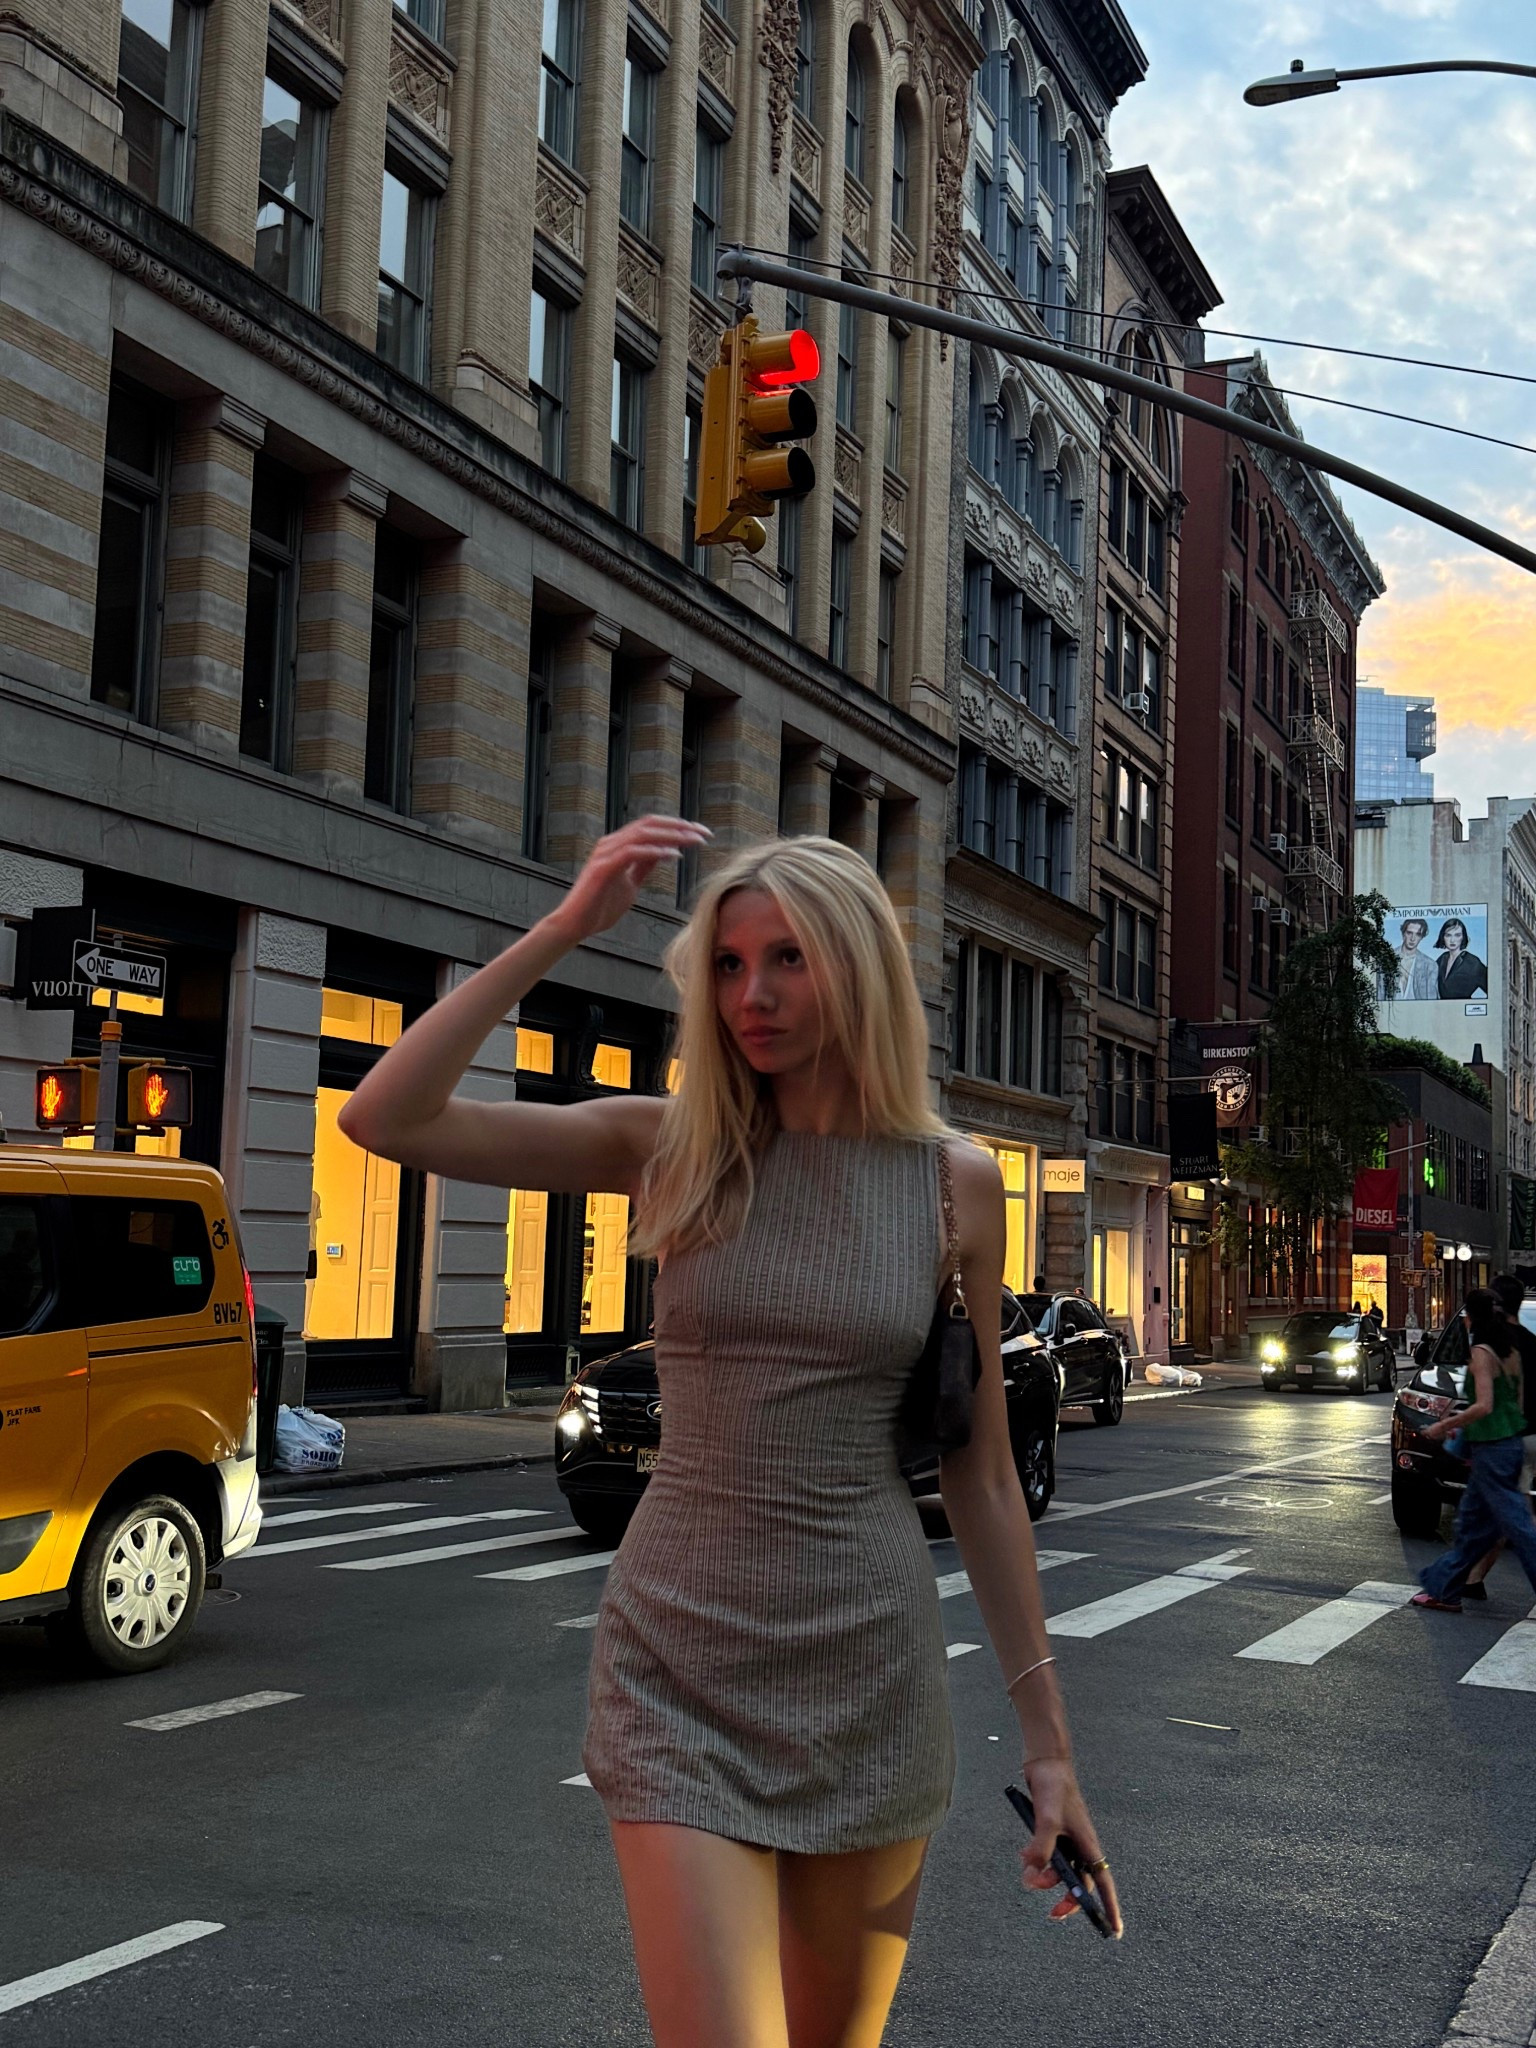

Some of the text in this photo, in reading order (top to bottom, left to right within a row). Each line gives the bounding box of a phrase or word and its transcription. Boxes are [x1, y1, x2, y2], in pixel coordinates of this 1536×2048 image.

[1393, 907, 1471, 918] EMPORIO ARMANI
[86, 956, 157, 984] ONE WAY
[1179, 1156, 1209, 1166] STUART
[1043, 1167, 1081, 1184] maje
[1172, 1164, 1218, 1175] WEITZMAN
[1355, 1207, 1395, 1225] DIESEL
[173, 1258, 200, 1272] curb
[6, 1405, 42, 1417] FLAT FARE
[7, 1418, 20, 1427] JFK
[301, 1449, 337, 1462] SOHO
